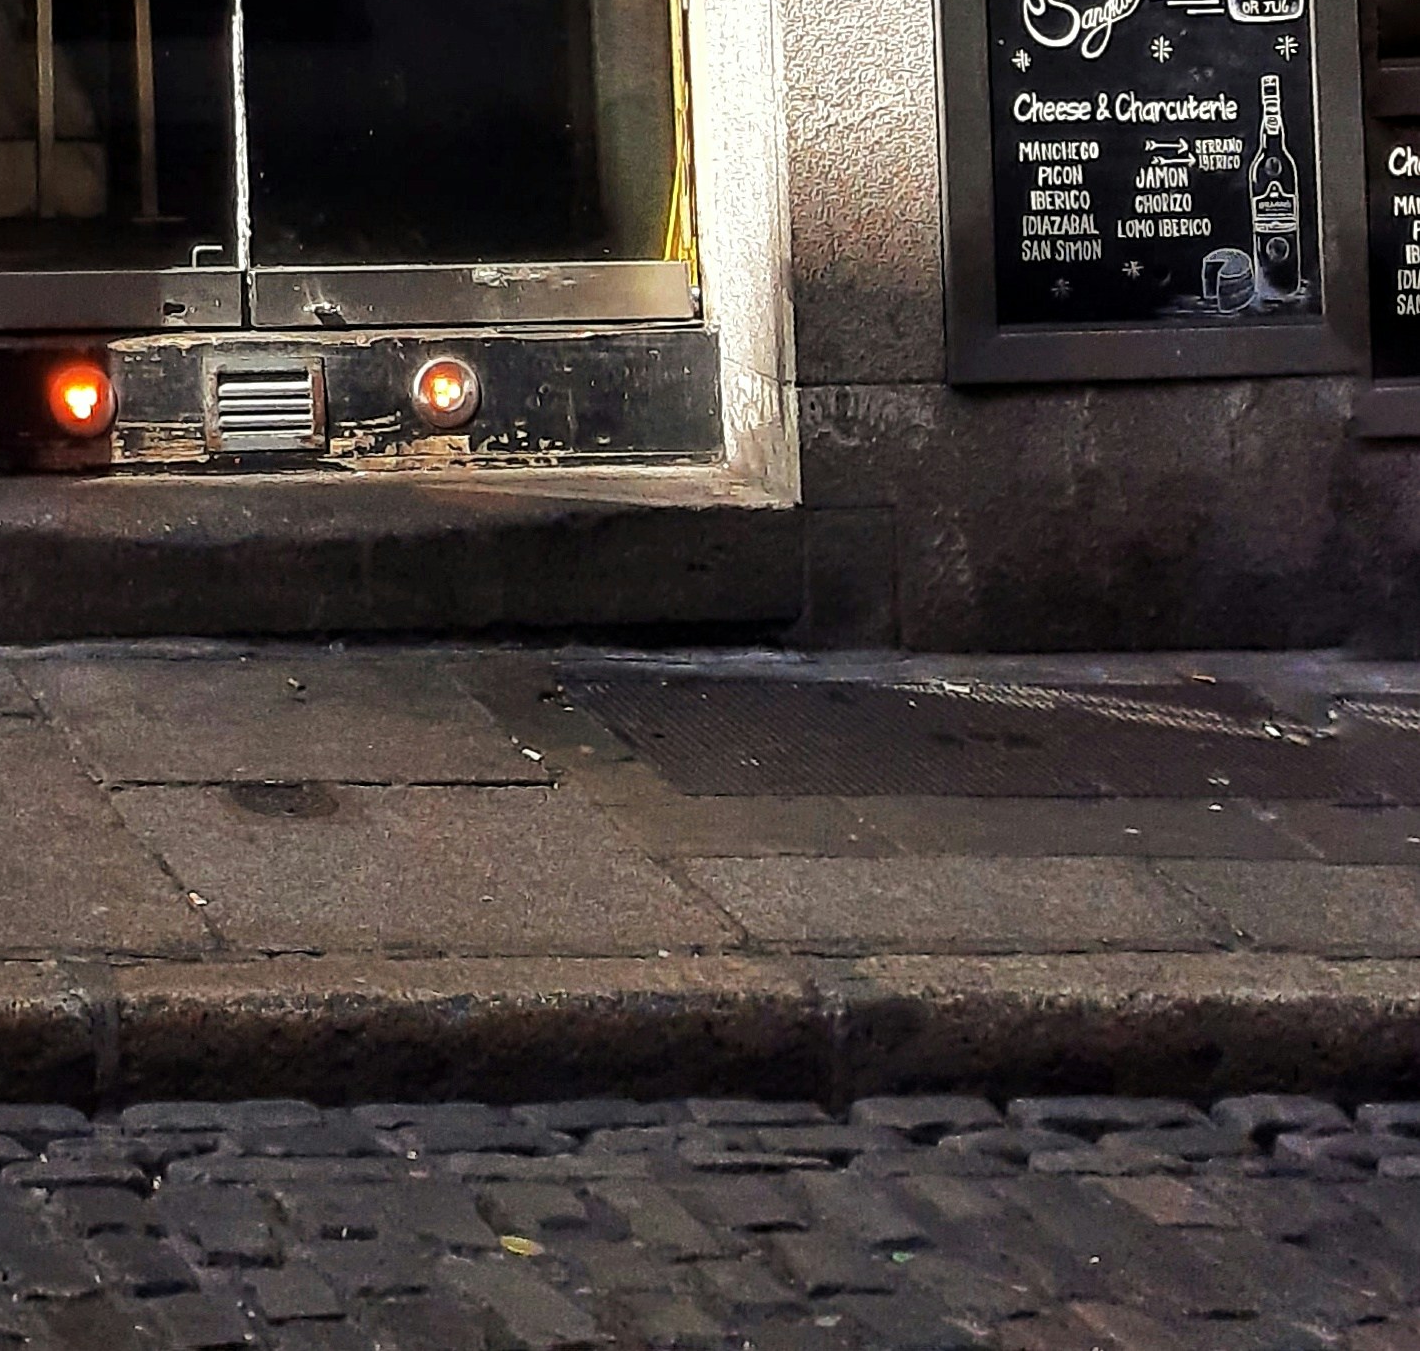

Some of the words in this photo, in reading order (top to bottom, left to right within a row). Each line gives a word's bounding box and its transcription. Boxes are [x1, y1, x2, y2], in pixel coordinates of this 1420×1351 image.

[1242, 0, 1261, 15] OR
[1013, 92, 1092, 123] Cheese
[1096, 94, 1112, 122] &
[1115, 91, 1239, 123] Charcuterie
[1018, 140, 1100, 163] MANCHEGO
[1037, 164, 1084, 188] PICON
[1135, 166, 1190, 189] JAMON
[1030, 190, 1091, 211] IBERICO
[1134, 191, 1193, 214] CHORIZO
[1022, 213, 1100, 237] IDIAZABAL
[1117, 218, 1155, 239] LOMO
[1158, 217, 1211, 238] IBERICO
[1021, 239, 1052, 263] SAN
[1055, 239, 1103, 263] SIMON
